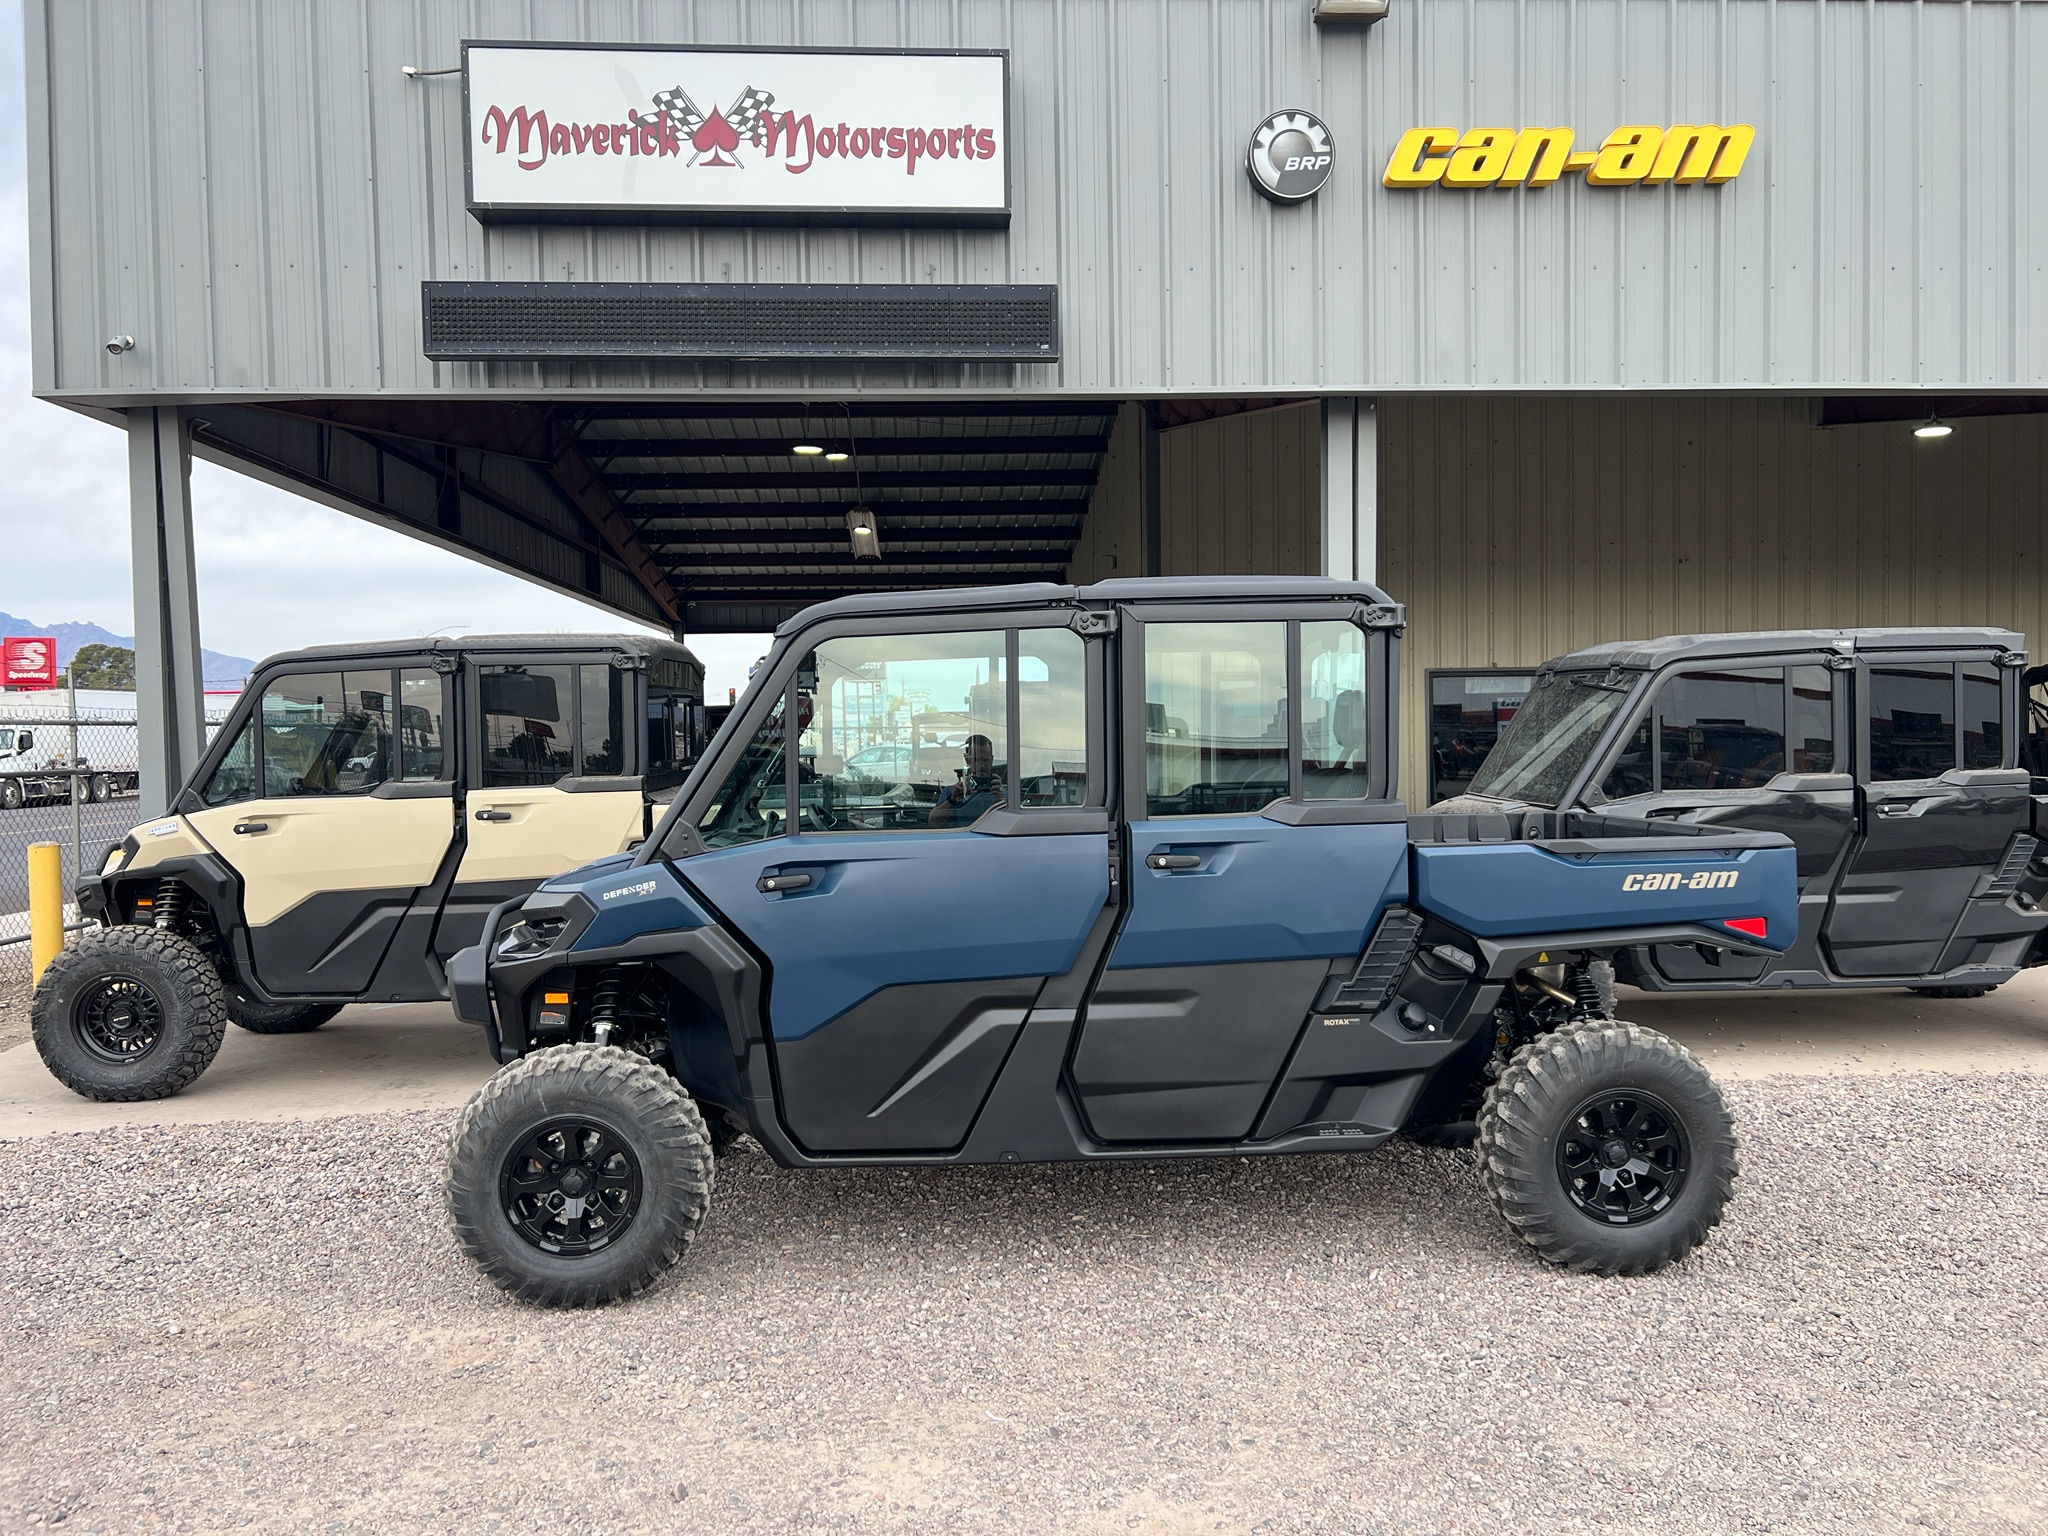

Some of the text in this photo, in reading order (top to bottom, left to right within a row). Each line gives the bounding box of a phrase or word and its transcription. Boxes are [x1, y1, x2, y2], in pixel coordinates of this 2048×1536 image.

[481, 104, 997, 175] Maverick Motorsports
[1284, 155, 1331, 171] BRP
[1383, 123, 1756, 188] can-am
[8, 670, 49, 680] Speedway
[1622, 870, 1739, 892] can-am
[602, 880, 657, 901] DEFENDER
[638, 887, 657, 896] XT
[1323, 1018, 1350, 1026] ROTAX
